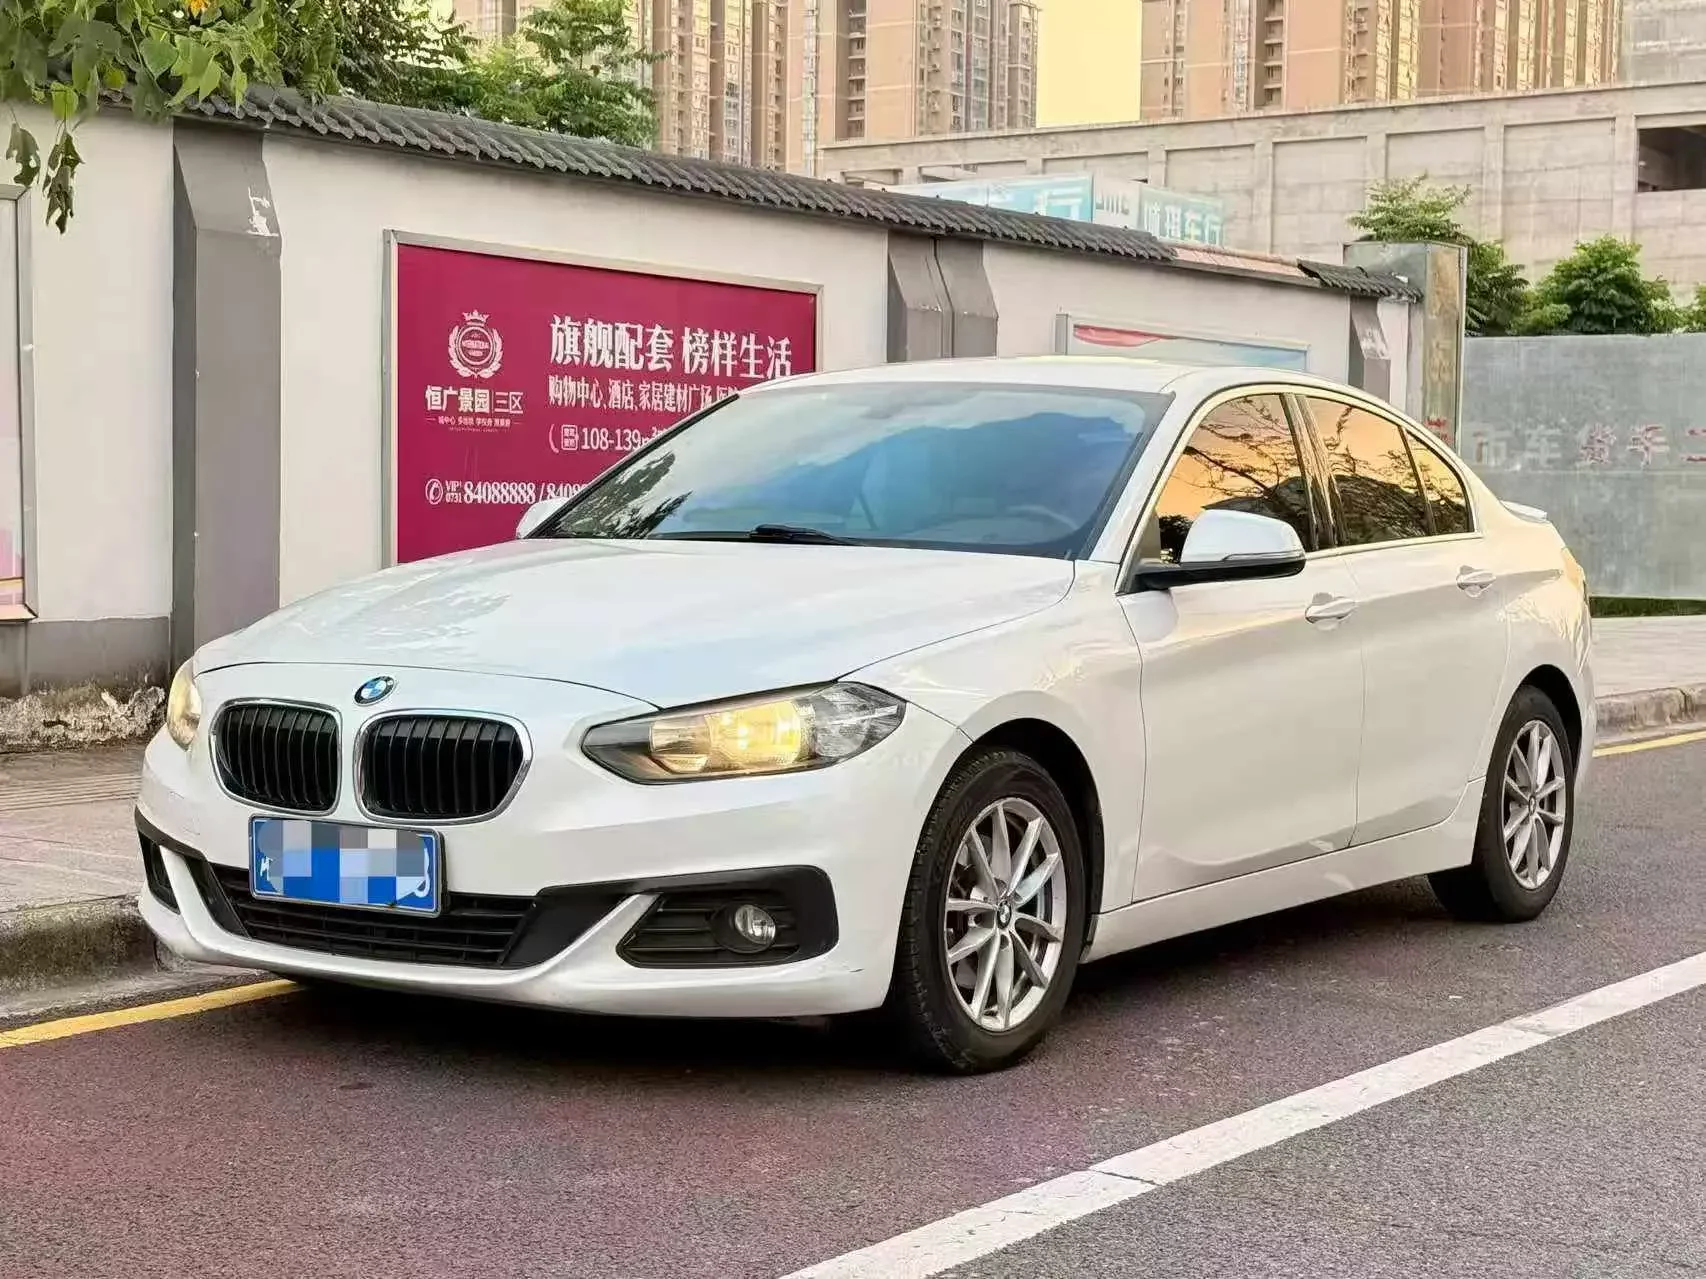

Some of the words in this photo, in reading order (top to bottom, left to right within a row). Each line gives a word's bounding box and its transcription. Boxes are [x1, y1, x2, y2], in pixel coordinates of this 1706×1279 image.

[551, 315, 675, 372] 旗舰配套
[682, 327, 793, 380] 榜样生活
[425, 385, 490, 413] 恒广景园
[494, 391, 524, 415] 三区
